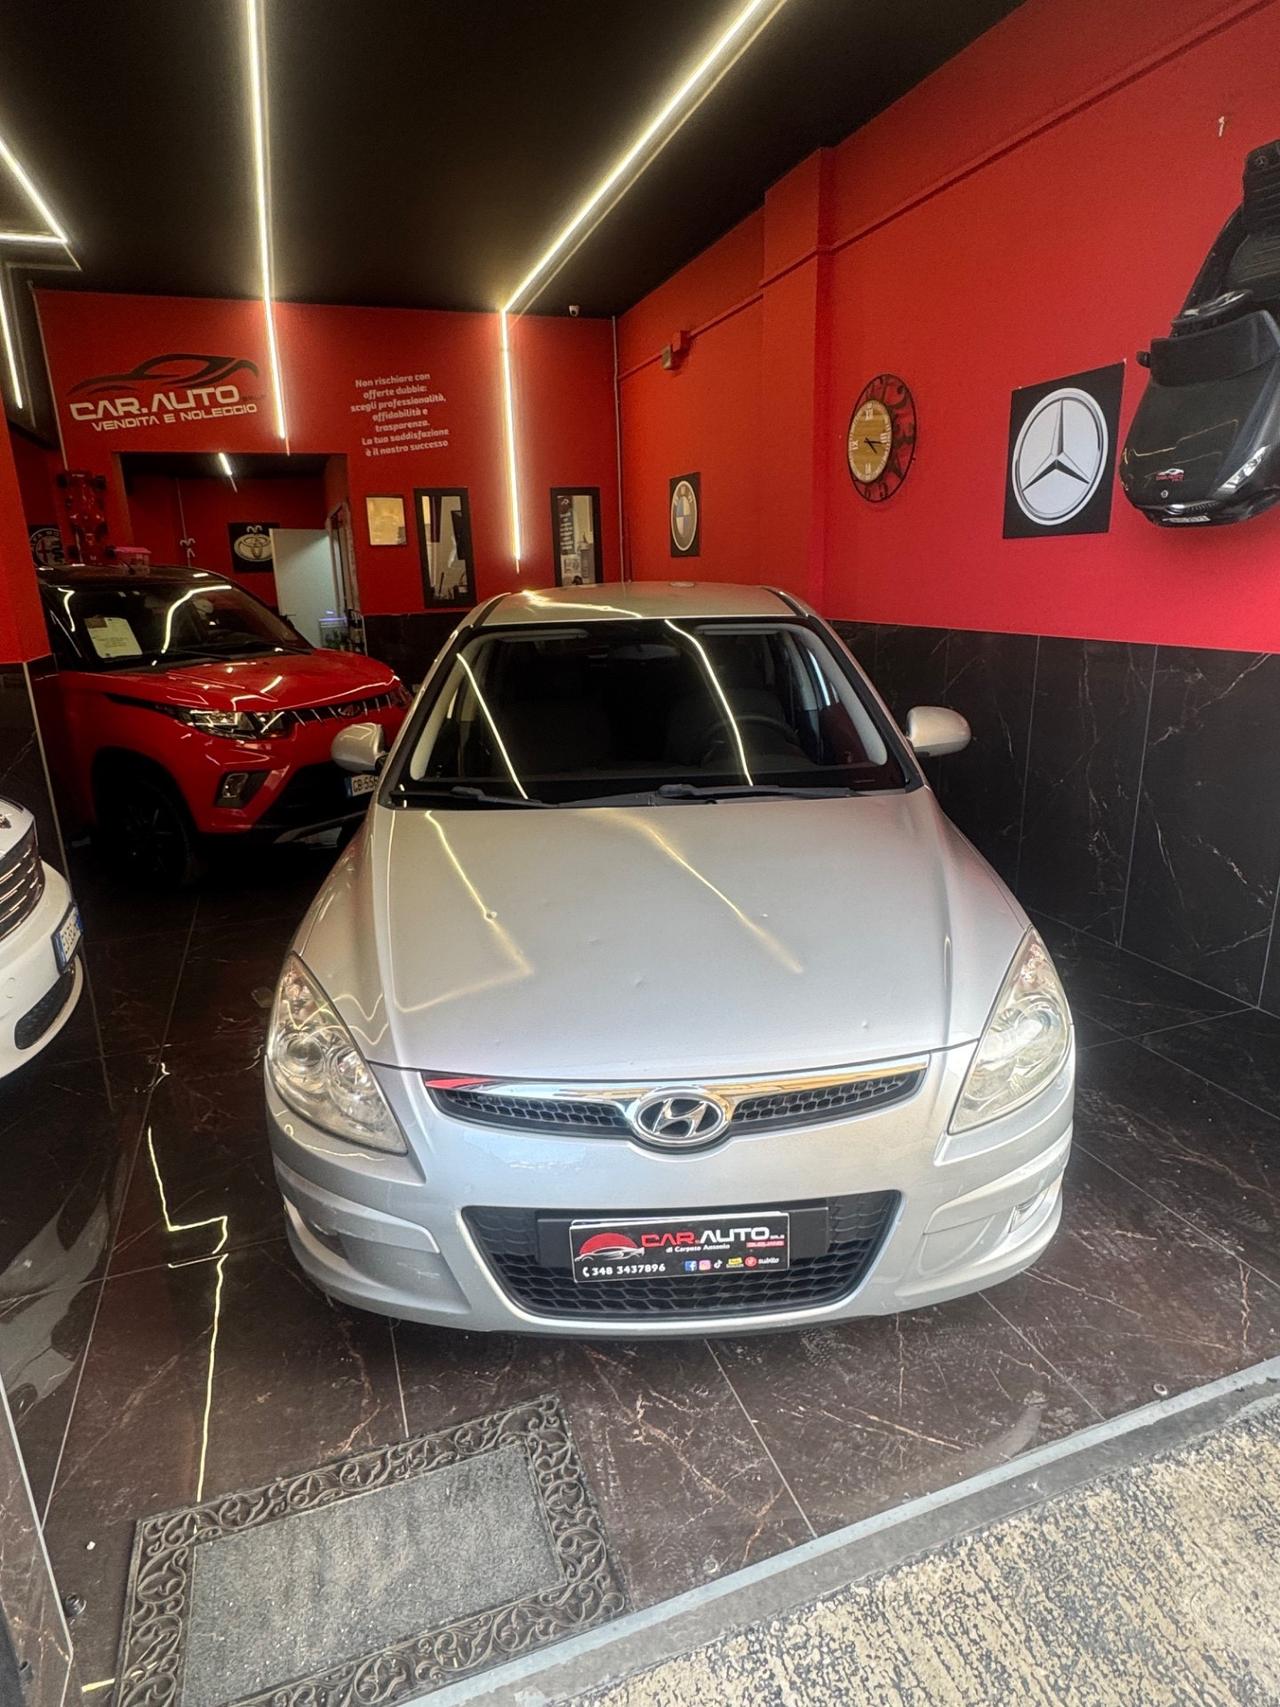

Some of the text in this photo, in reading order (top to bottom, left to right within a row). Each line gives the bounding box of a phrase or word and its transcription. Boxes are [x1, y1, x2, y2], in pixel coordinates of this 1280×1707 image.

[355, 373, 430, 388] Non rischiare con
[363, 388, 394, 399] offerte
[69, 385, 239, 421] CAR.AUTO
[350, 401, 377, 412] scegli
[91, 403, 257, 431] VENDITA E NOLEGGIO
[372, 407, 421, 422] affidabilità
[361, 428, 449, 446] La tua soddisfazione
[365, 440, 448, 457] è il nostro successo
[591, 1263, 666, 1276] 348 3437896
